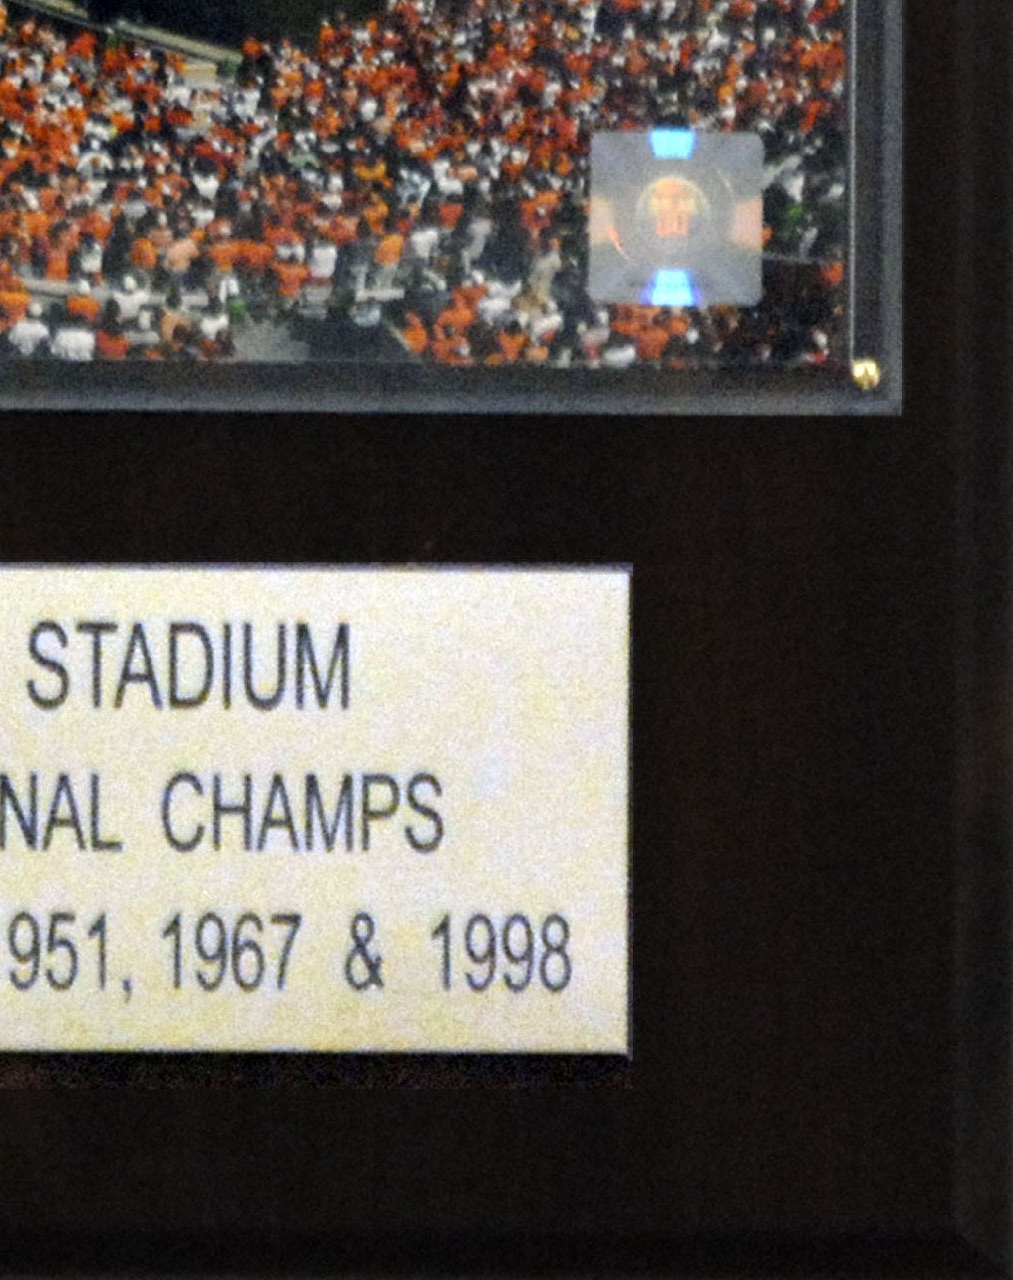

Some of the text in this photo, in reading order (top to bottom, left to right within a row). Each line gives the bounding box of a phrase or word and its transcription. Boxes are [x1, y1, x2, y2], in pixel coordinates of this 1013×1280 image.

[26, 620, 350, 711] STADIUM
[161, 771, 444, 854] CHAMPS
[162, 911, 302, 992] 1967
[344, 912, 385, 993] &
[431, 913, 572, 994] 1998
